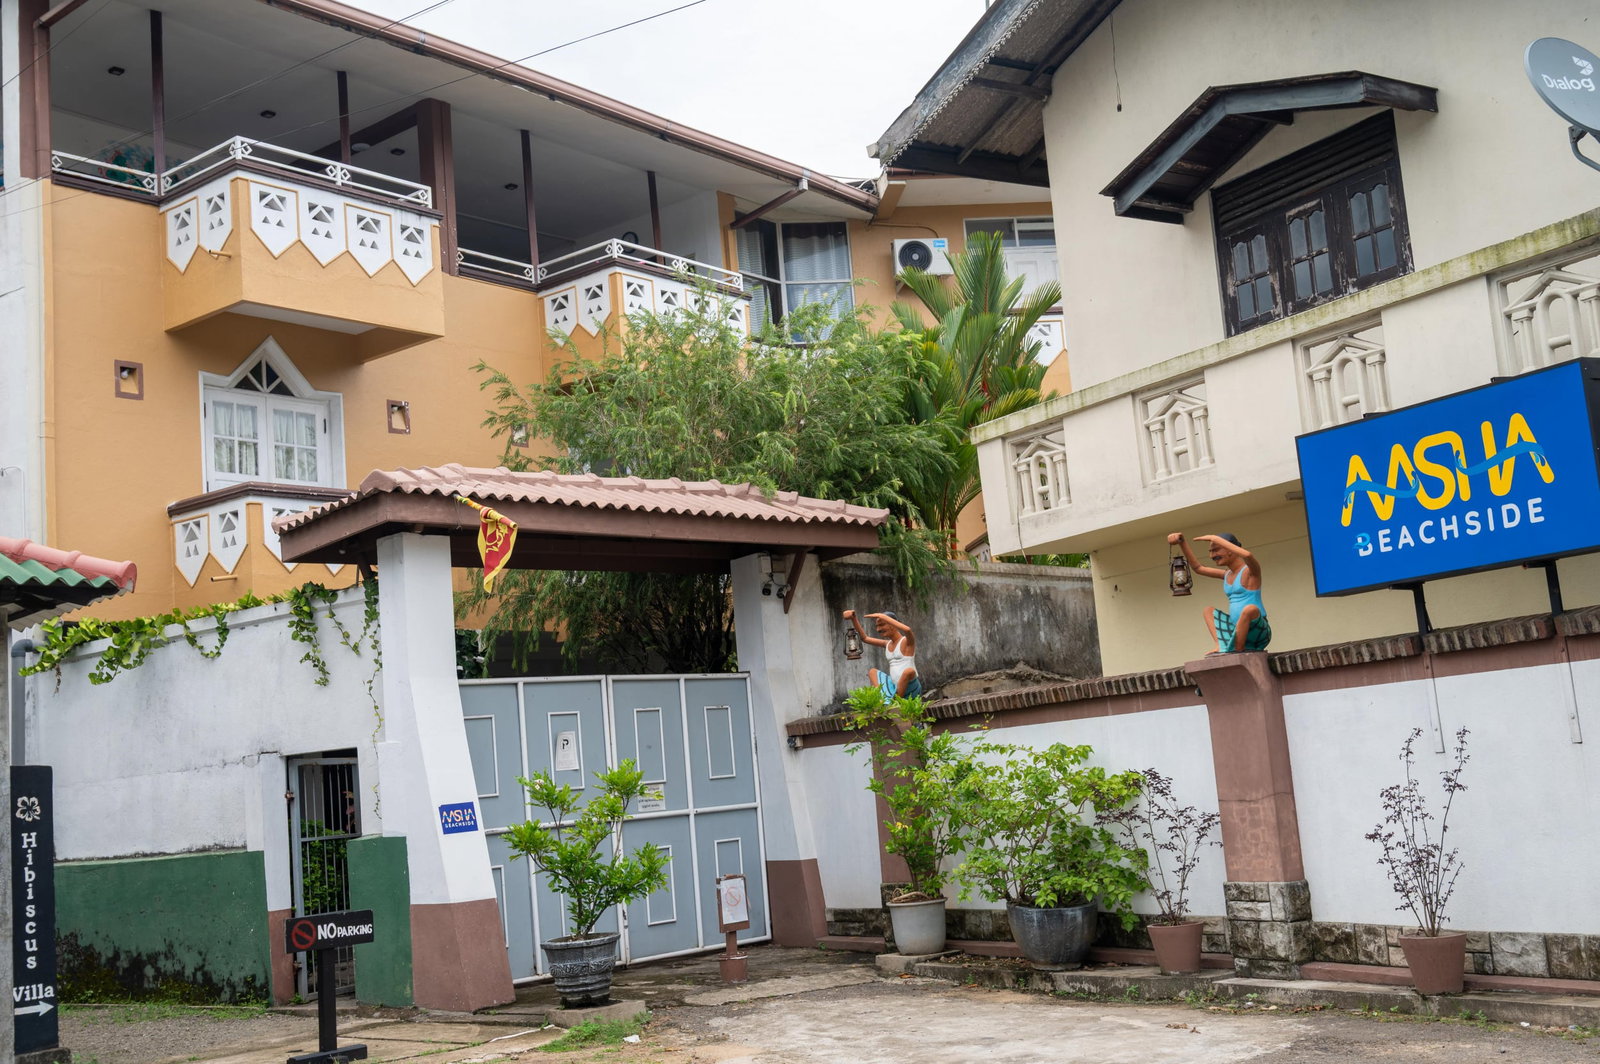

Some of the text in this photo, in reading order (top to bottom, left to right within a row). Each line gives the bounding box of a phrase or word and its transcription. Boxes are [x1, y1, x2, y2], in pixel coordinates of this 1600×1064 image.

[1541, 73, 1596, 92] Dialog
[1353, 497, 1545, 557] BEACHSIDE
[445, 820, 475, 829] BEACHSIDE
[21, 831, 38, 970] Hibiscus
[317, 922, 337, 940] NO
[13, 983, 55, 1002] Villa
